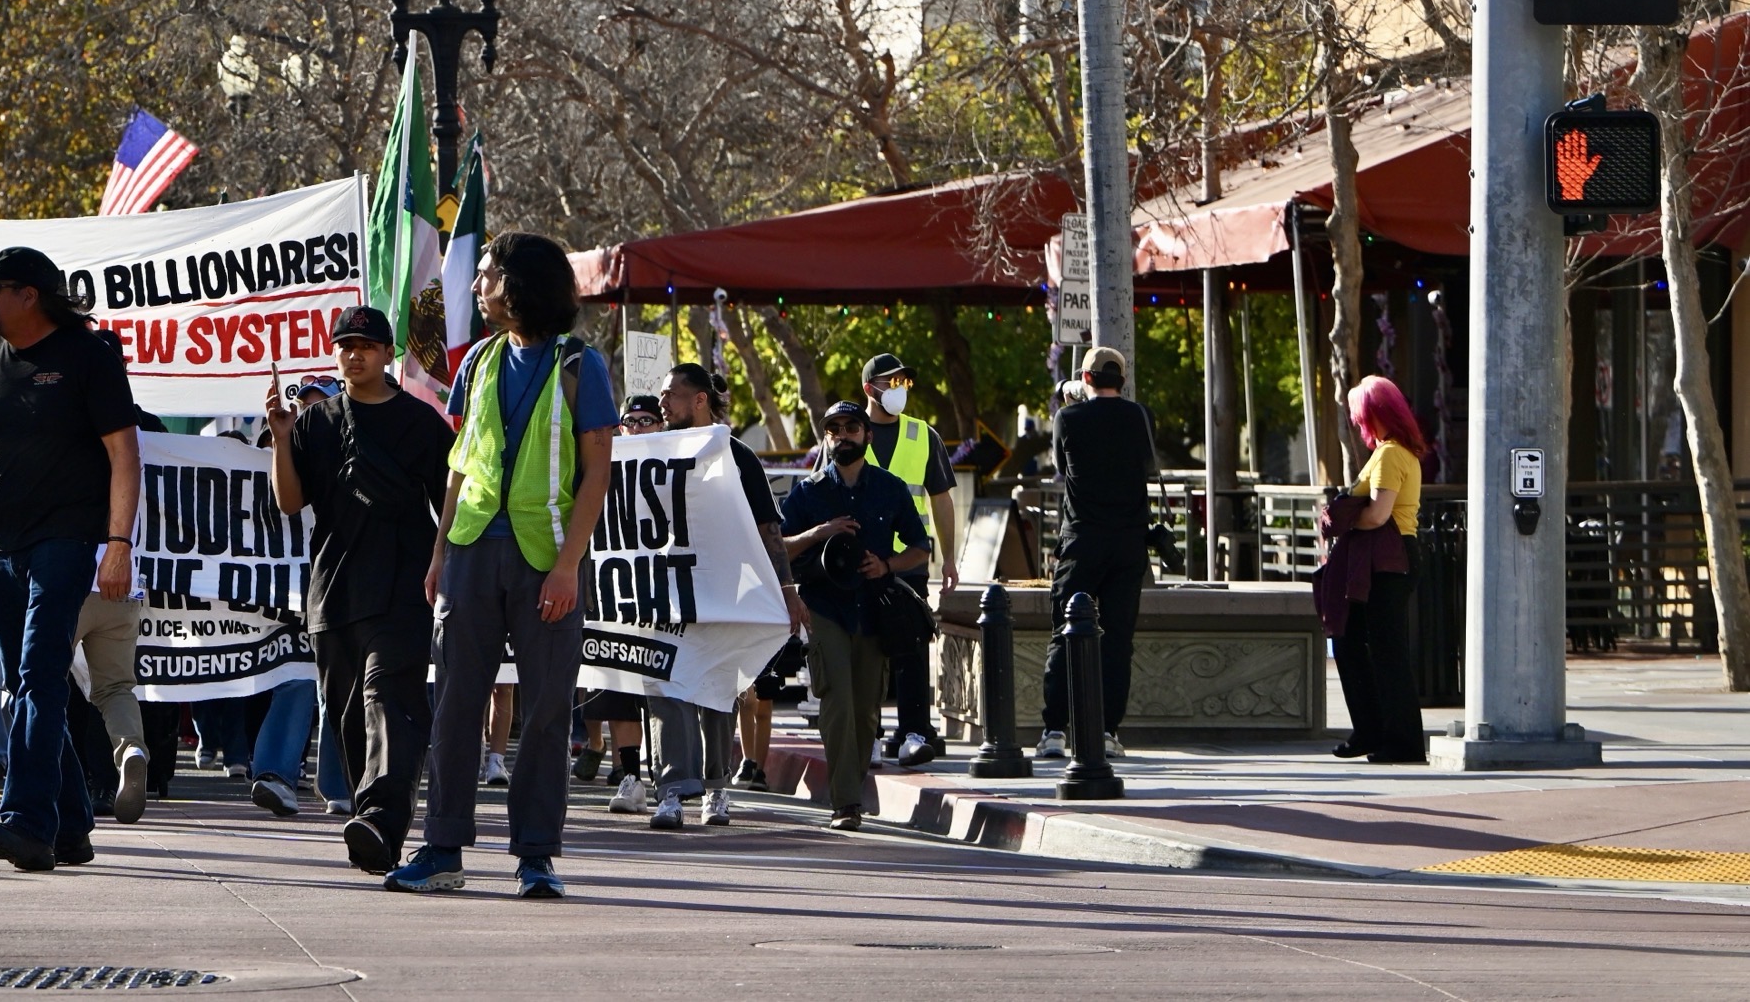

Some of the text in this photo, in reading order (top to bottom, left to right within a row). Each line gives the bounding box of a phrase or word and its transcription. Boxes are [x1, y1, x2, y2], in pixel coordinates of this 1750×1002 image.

[104, 232, 360, 310] BILLIONARES!
[156, 620, 188, 640] ICE,
[192, 620, 215, 637] NO
[140, 651, 252, 678] STUDENTS
[257, 633, 293, 666] FOR
[583, 638, 670, 670] @SFSATUCI
